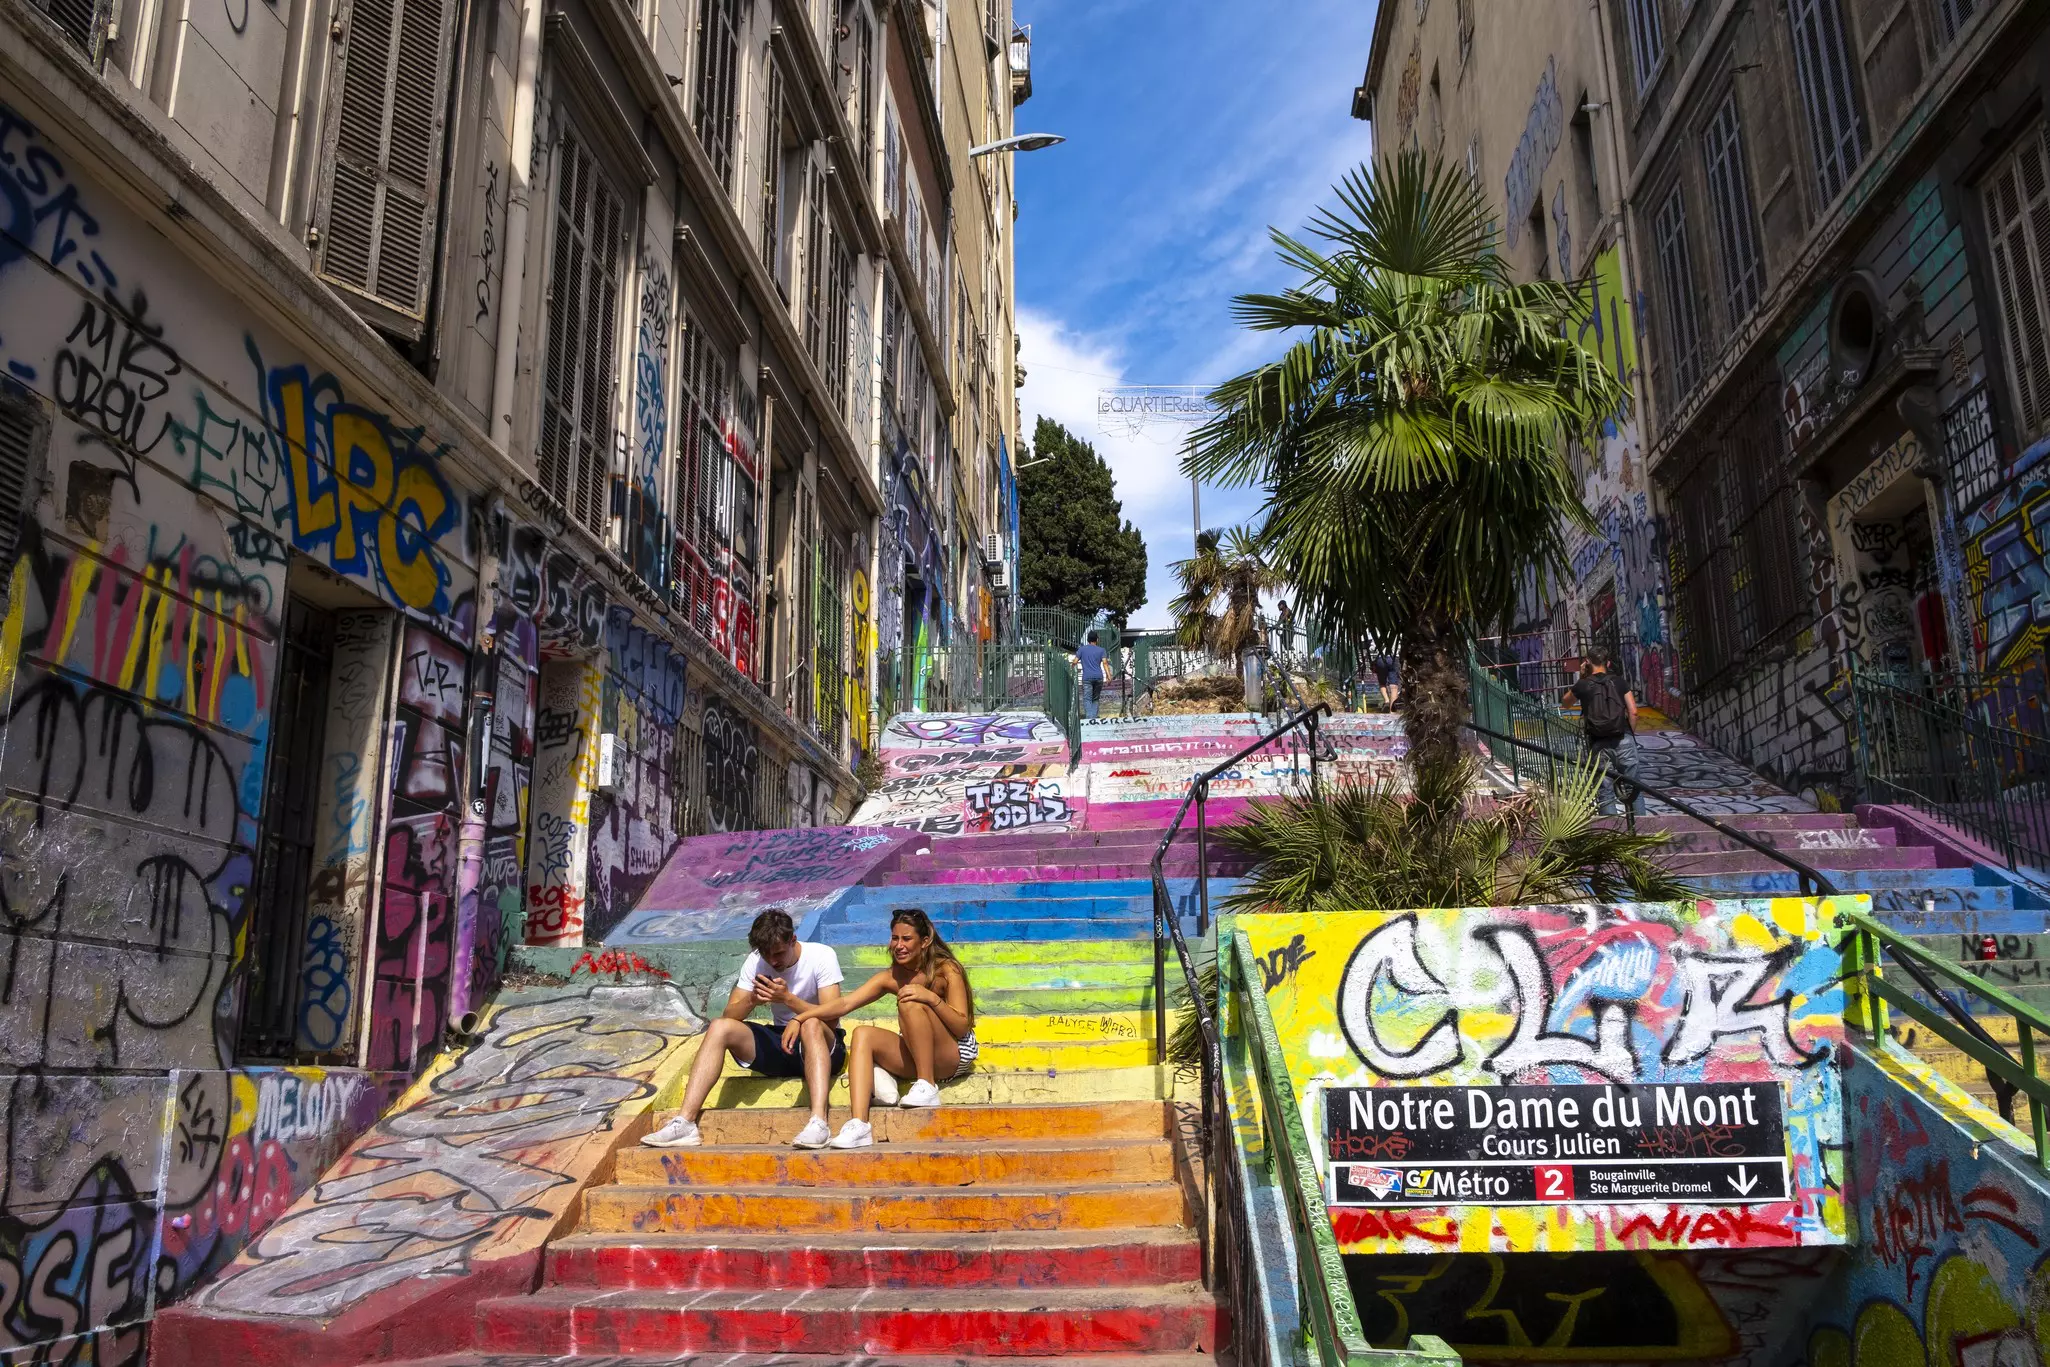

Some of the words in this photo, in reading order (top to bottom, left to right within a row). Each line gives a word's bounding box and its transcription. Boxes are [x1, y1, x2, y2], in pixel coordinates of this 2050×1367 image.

[1110, 396, 1182, 413] QUARTIER
[1350, 1090, 1455, 1131] Notre
[1467, 1088, 1579, 1130] Dame
[1592, 1085, 1643, 1129] du
[1656, 1085, 1759, 1127] Mont
[1482, 1134, 1549, 1156] Cours
[1554, 1132, 1621, 1159] Julien
[1350, 1174, 1367, 1185] G7
[1406, 1169, 1434, 1189] G7
[1434, 1169, 1510, 1197] Métro
[1543, 1169, 1565, 1196] 2
[1589, 1169, 1656, 1182] Bougainville
[1590, 1183, 1609, 1194] Ste
[1611, 1182, 1670, 1195] Marguerite
[1672, 1181, 1712, 1193] Dromel
